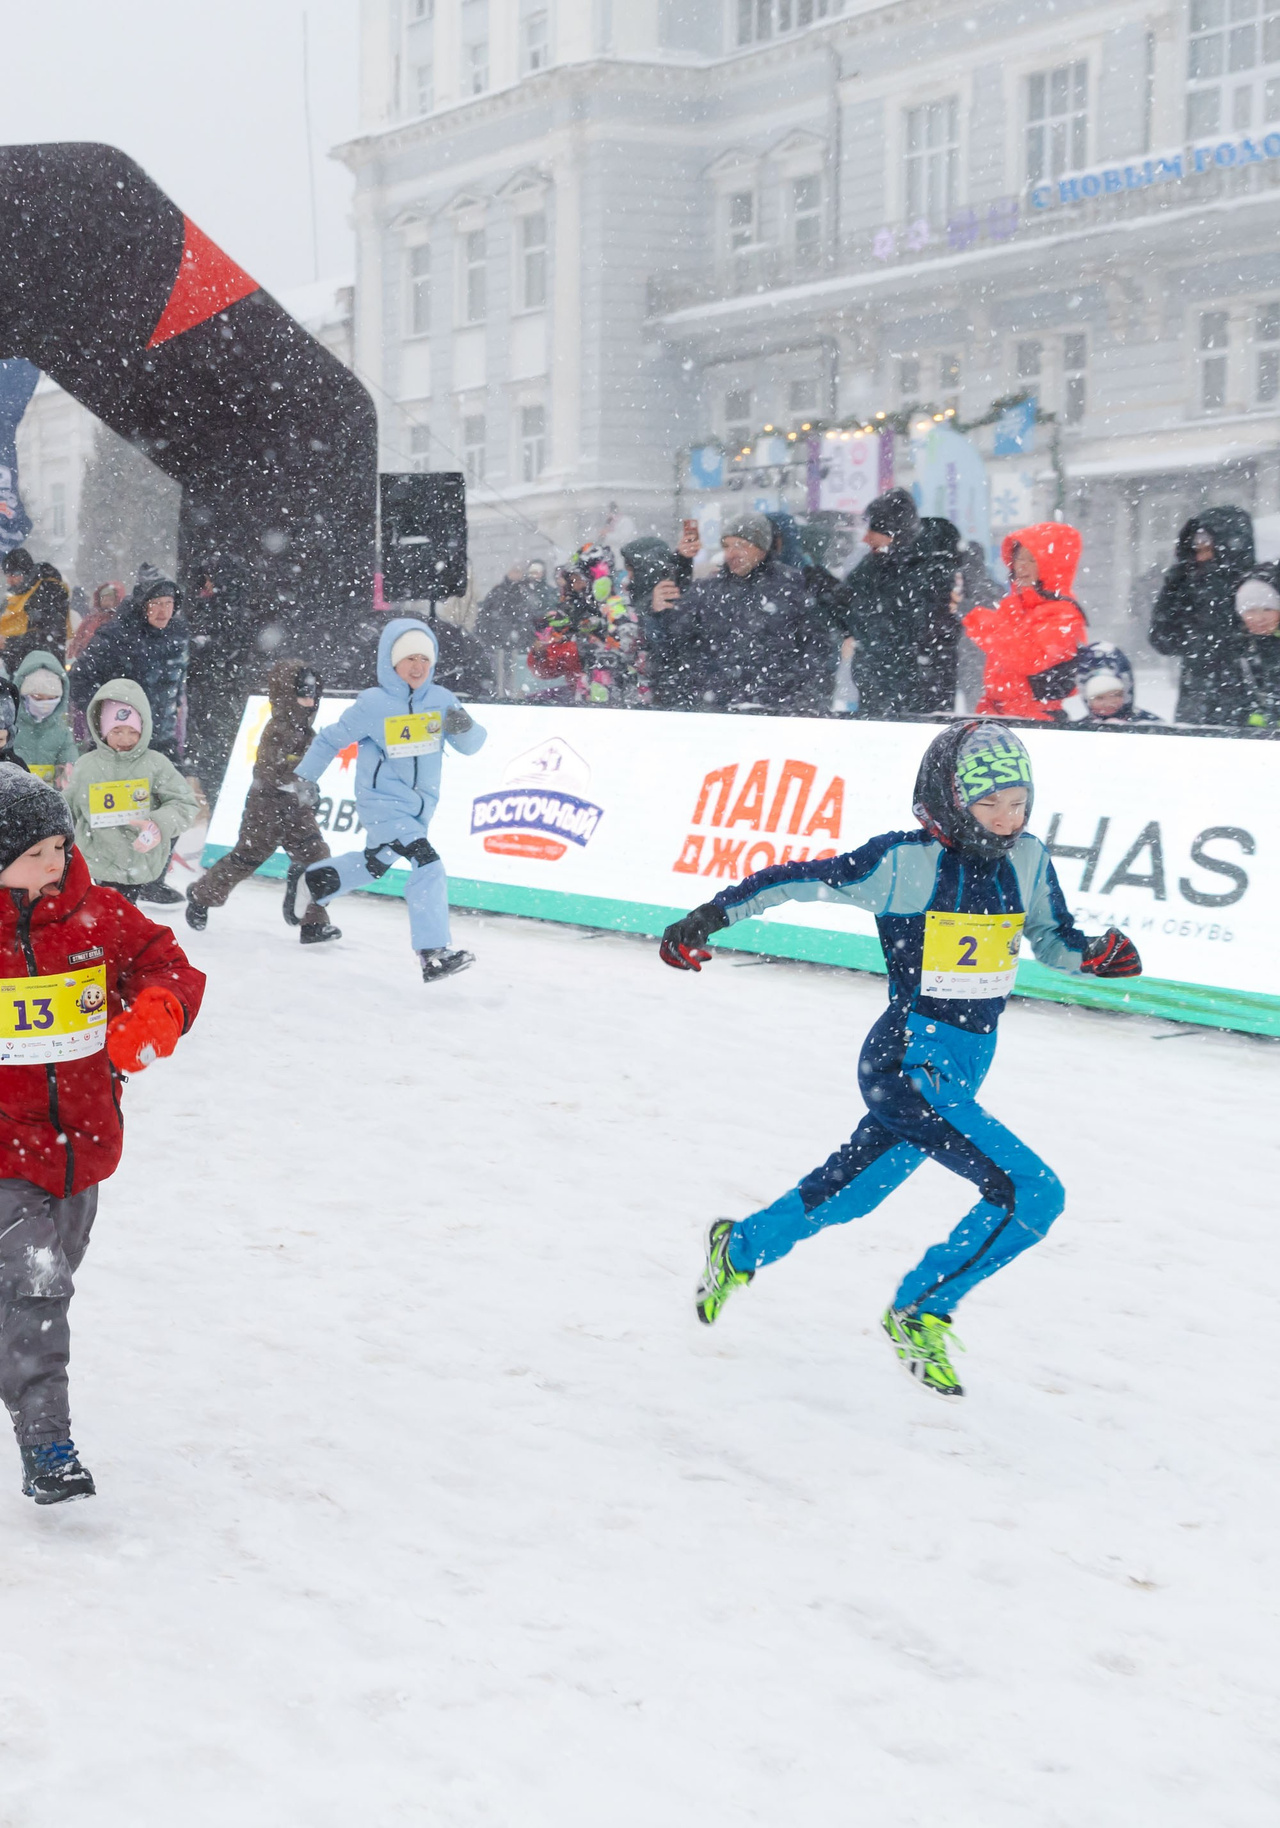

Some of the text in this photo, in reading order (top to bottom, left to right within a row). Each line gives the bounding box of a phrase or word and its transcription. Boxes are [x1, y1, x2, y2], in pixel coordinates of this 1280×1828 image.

[1030, 186, 1052, 209] С
[1058, 155, 1184, 205] НОВЫМ
[400, 726, 411, 740] 4
[103, 793, 115, 809] 8
[691, 759, 845, 839] ПАПА
[473, 796, 600, 841] ВОСТОЧНЫЙ
[1045, 812, 1256, 907] HAS
[1141, 917, 1155, 930] И
[1163, 918, 1234, 942] ОБУВЬ
[956, 936, 978, 966] 2
[13, 998, 54, 1031] 13
